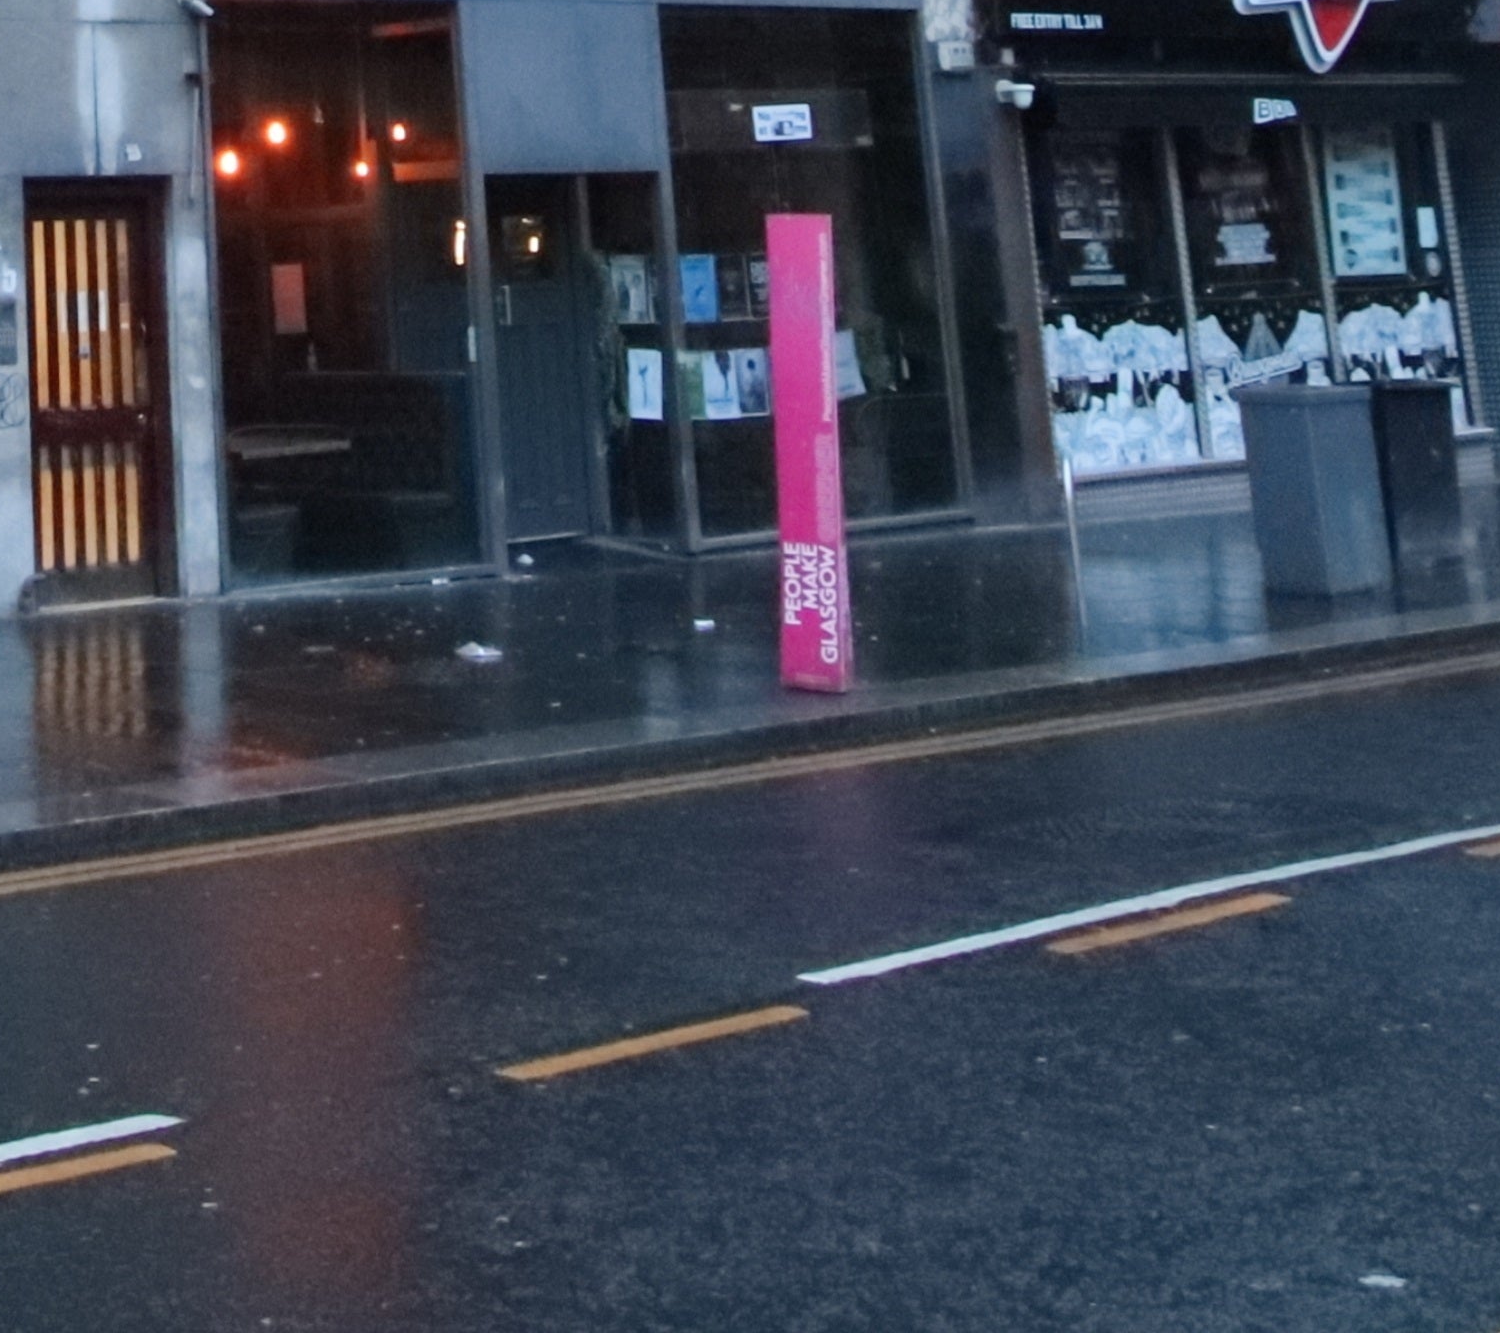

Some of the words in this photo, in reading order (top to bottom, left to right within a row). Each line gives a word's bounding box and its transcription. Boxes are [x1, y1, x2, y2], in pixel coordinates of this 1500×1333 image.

[783, 541, 802, 626] PEOPLE
[800, 542, 819, 610] MAKE
[818, 545, 840, 665] GLASGOW
